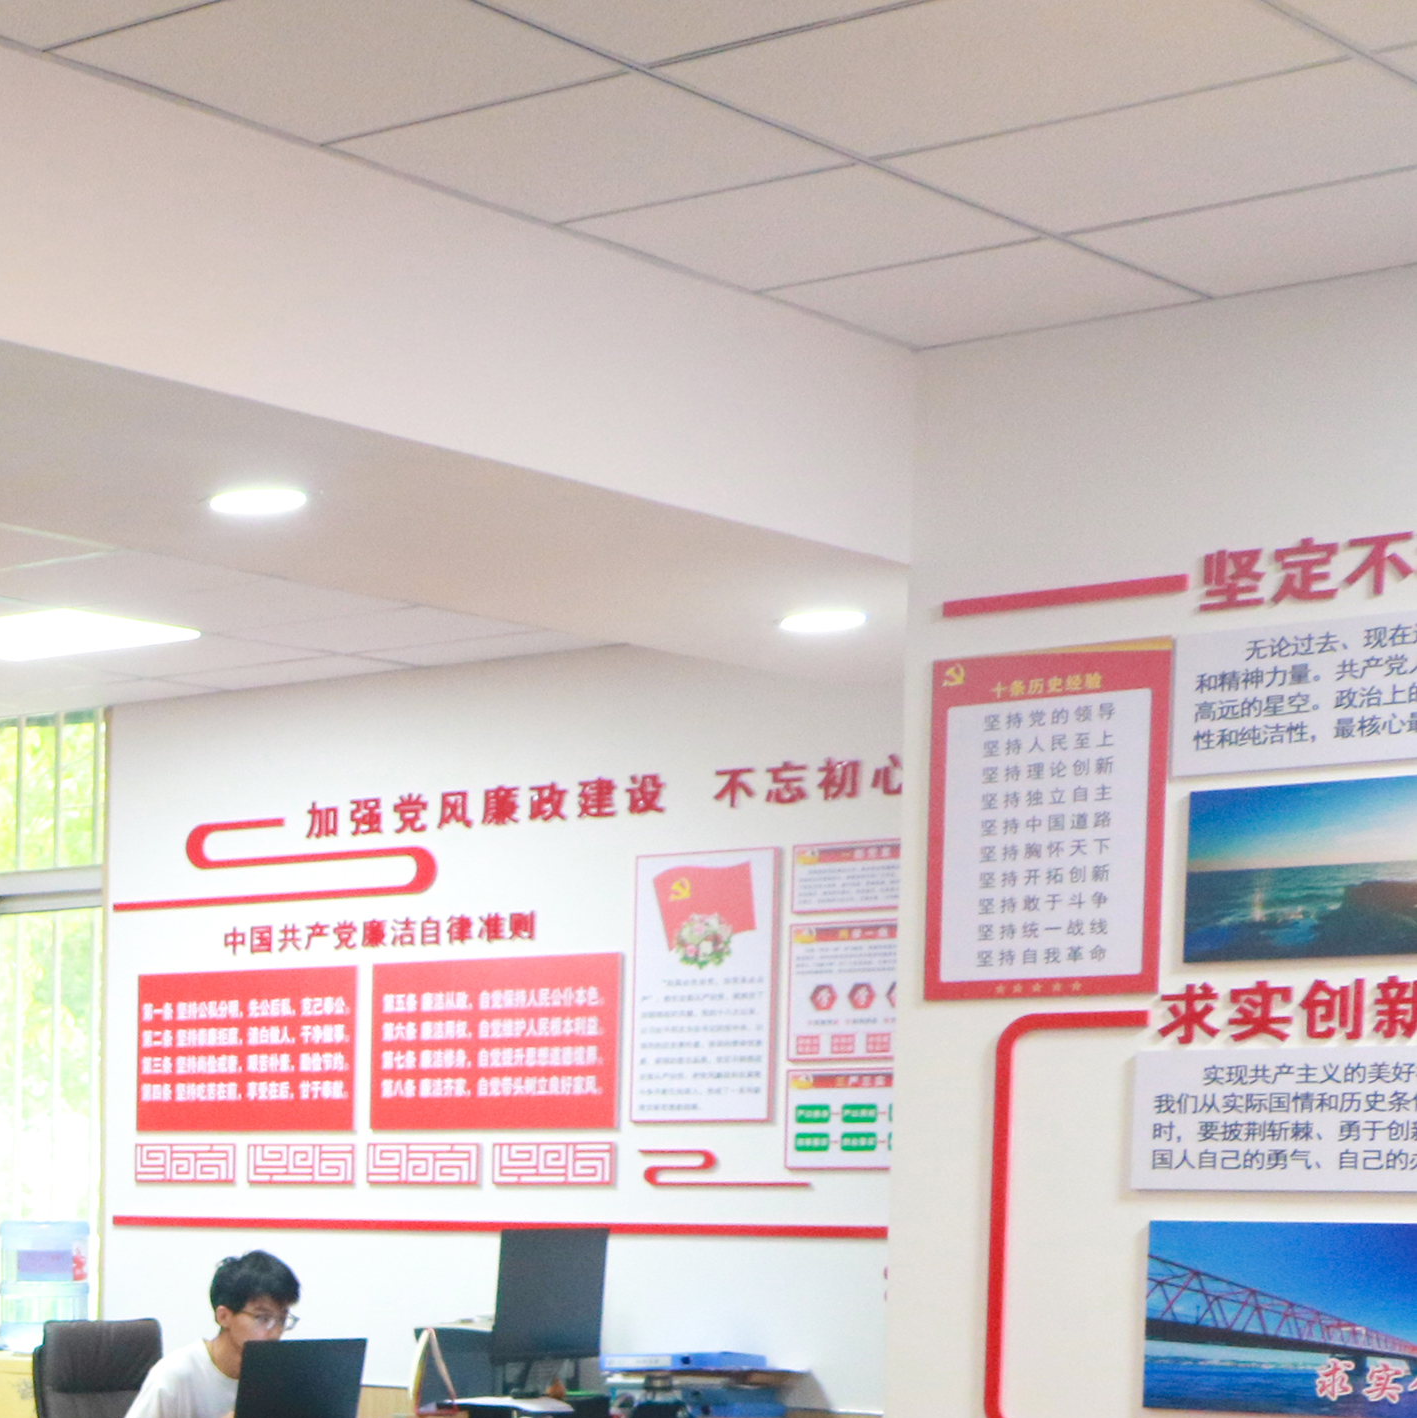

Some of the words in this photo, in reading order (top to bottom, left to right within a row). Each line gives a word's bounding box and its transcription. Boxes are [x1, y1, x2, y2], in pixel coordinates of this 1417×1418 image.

[1199, 531, 1414, 611] 坚定不
[1245, 623, 1417, 661] 无论过去、现在
[992, 672, 1103, 698] 十条历史经验
[983, 702, 1116, 732] 坚持党的领导
[982, 729, 1115, 758] 坚持人民至上
[981, 756, 1115, 785] 坚持理论创新
[304, 773, 667, 840] 加强党风廉政建设
[713, 755, 904, 808] 不忘初心
[981, 783, 1114, 811] 坚持独立自主
[980, 811, 1112, 838] 坚持中国道路
[979, 837, 1111, 864] 坚持胸怀天下
[978, 863, 1110, 889] 坚持开拓创新
[978, 891, 1109, 915] 坚持敢于斗争
[222, 910, 536, 956] 中国共产党廉洁自律准则
[977, 917, 1108, 941] 坚持统一战线
[976, 944, 1107, 968] 坚持自我革命
[1158, 976, 1417, 1044] 求实创新
[1203, 1062, 1417, 1086] 实现共产主义的美好
[1315, 1358, 1417, 1405] 求实
